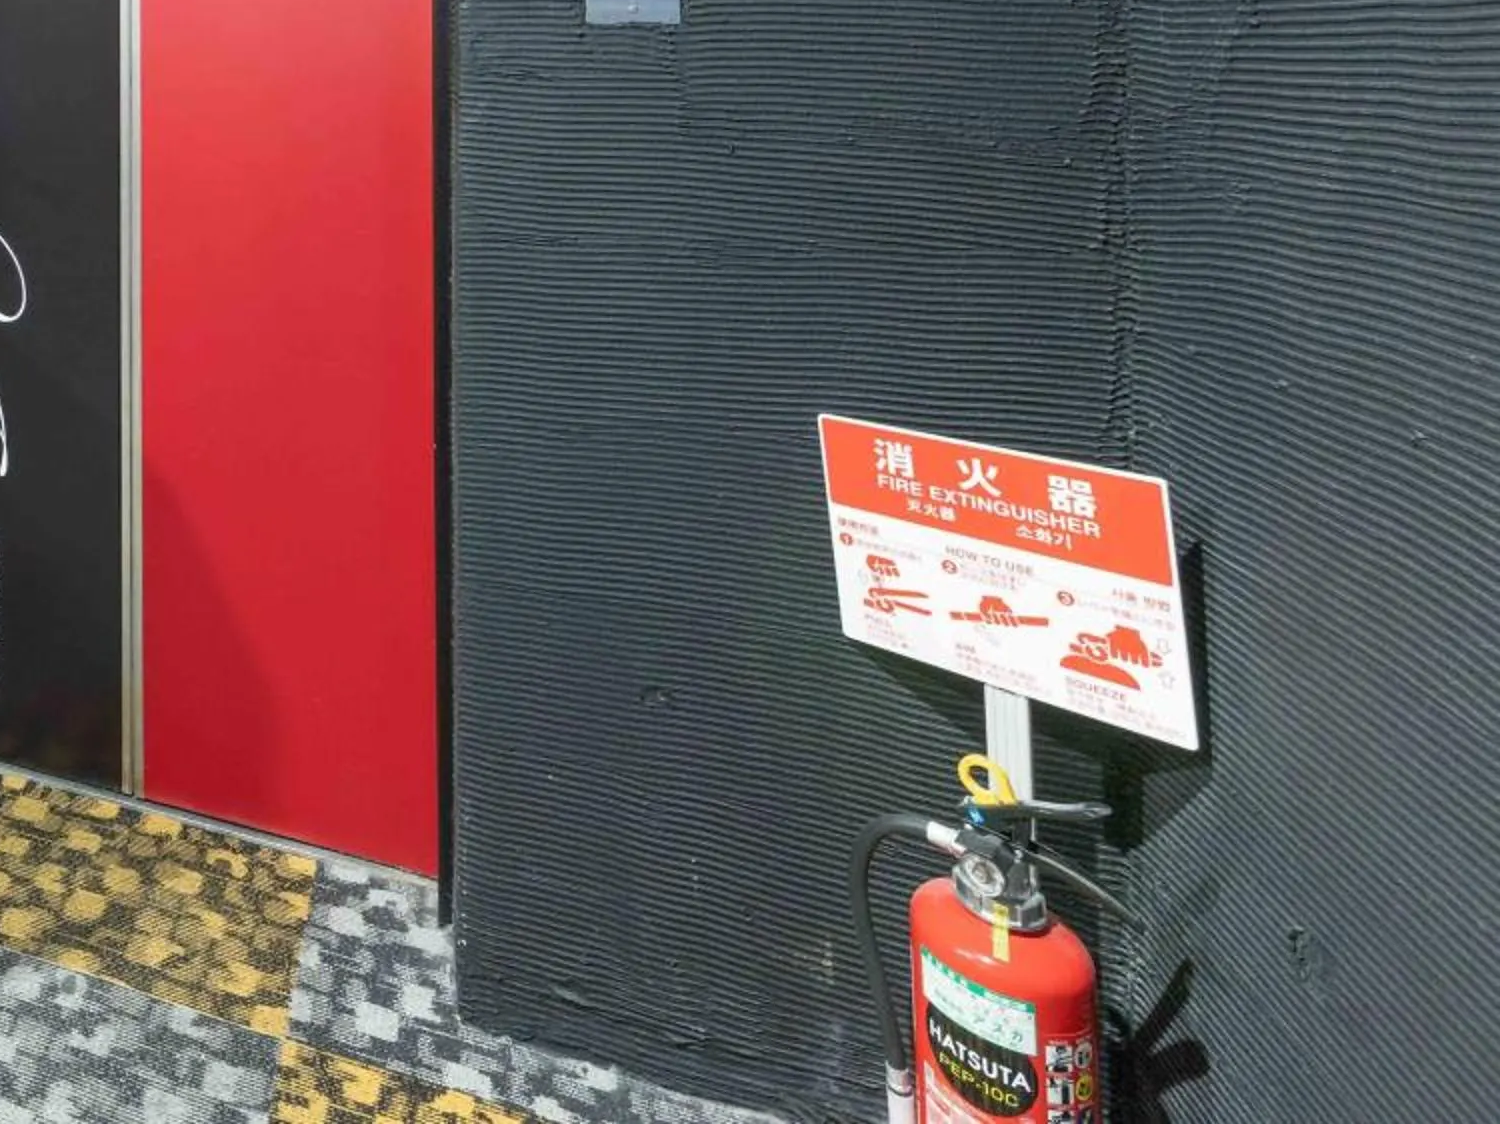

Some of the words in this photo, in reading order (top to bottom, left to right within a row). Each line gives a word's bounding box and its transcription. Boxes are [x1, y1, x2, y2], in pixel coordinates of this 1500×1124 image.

[873, 438, 1098, 519] 消火器
[876, 473, 923, 498] FIRE
[928, 485, 1101, 539] EXTINGUISHER
[929, 1018, 1032, 1093] HATSUTA
